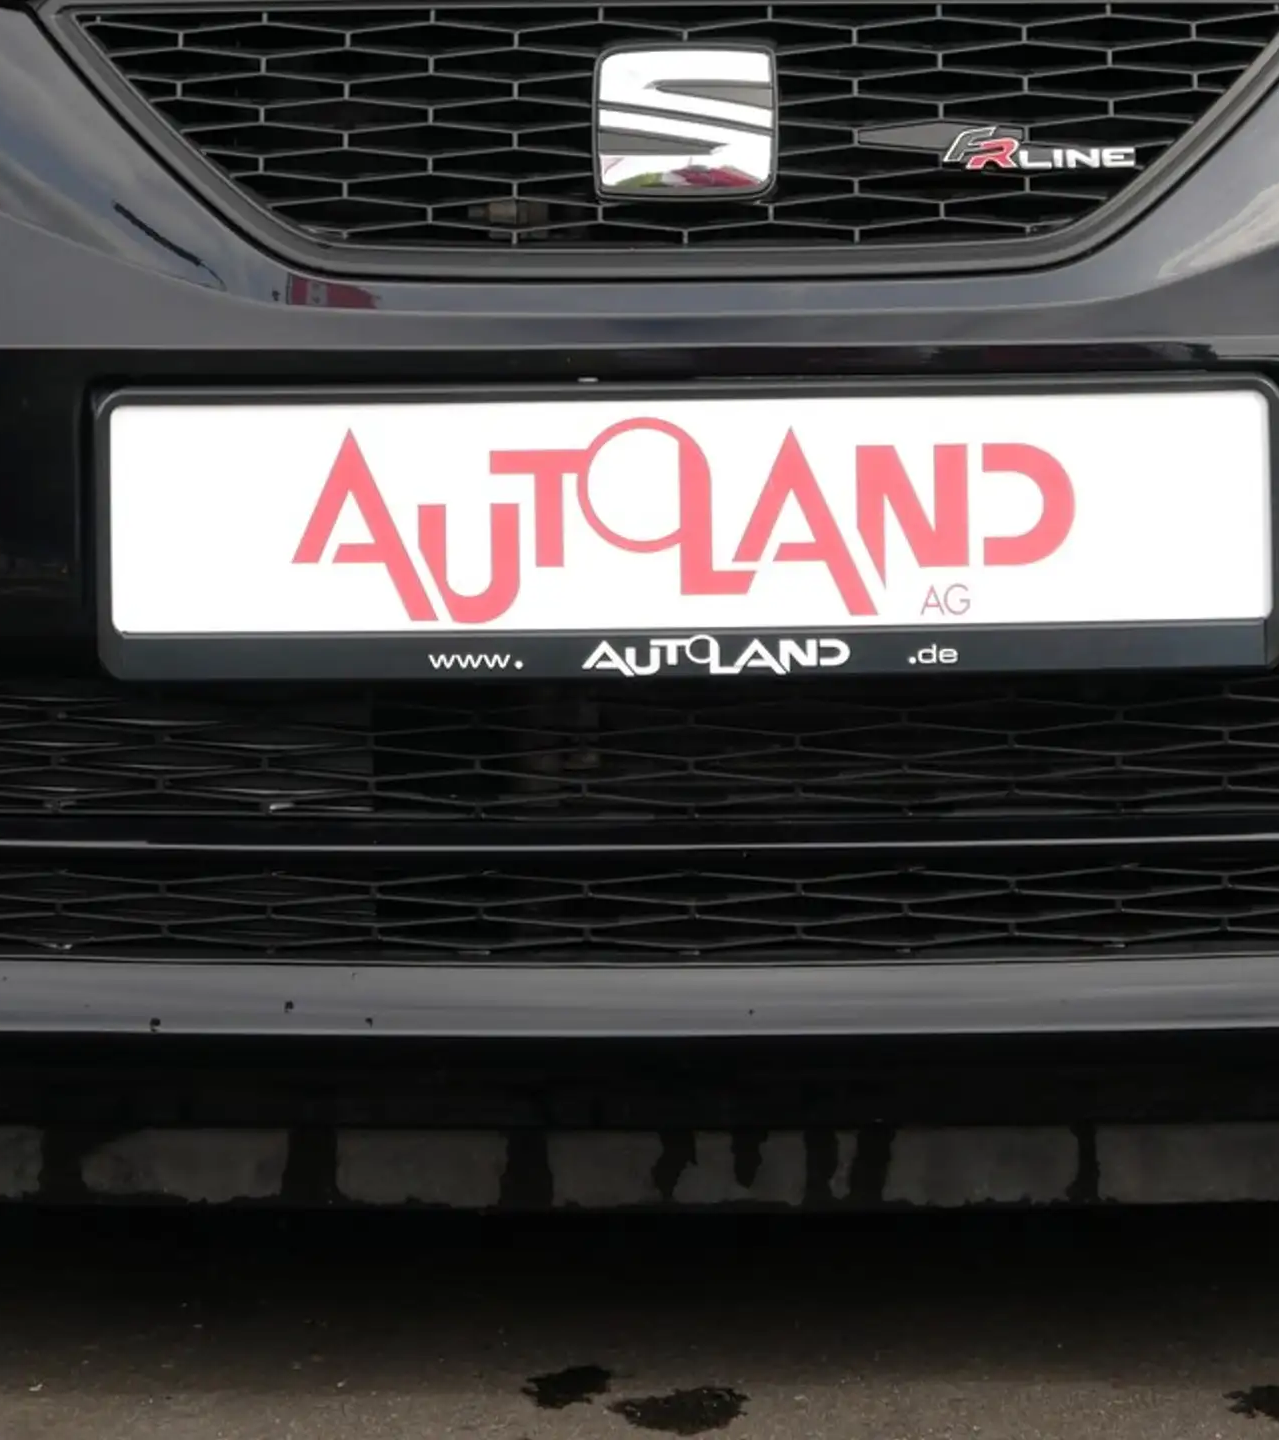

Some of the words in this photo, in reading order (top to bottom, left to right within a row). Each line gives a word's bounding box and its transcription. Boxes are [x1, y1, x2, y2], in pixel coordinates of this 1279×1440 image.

[1019, 147, 1136, 170] LINE
[292, 417, 1076, 624] AUTOLAND
[920, 583, 971, 616] AG
[428, 653, 524, 669] www.
[582, 634, 852, 677] AUTOLAND
[908, 643, 959, 665] .de
